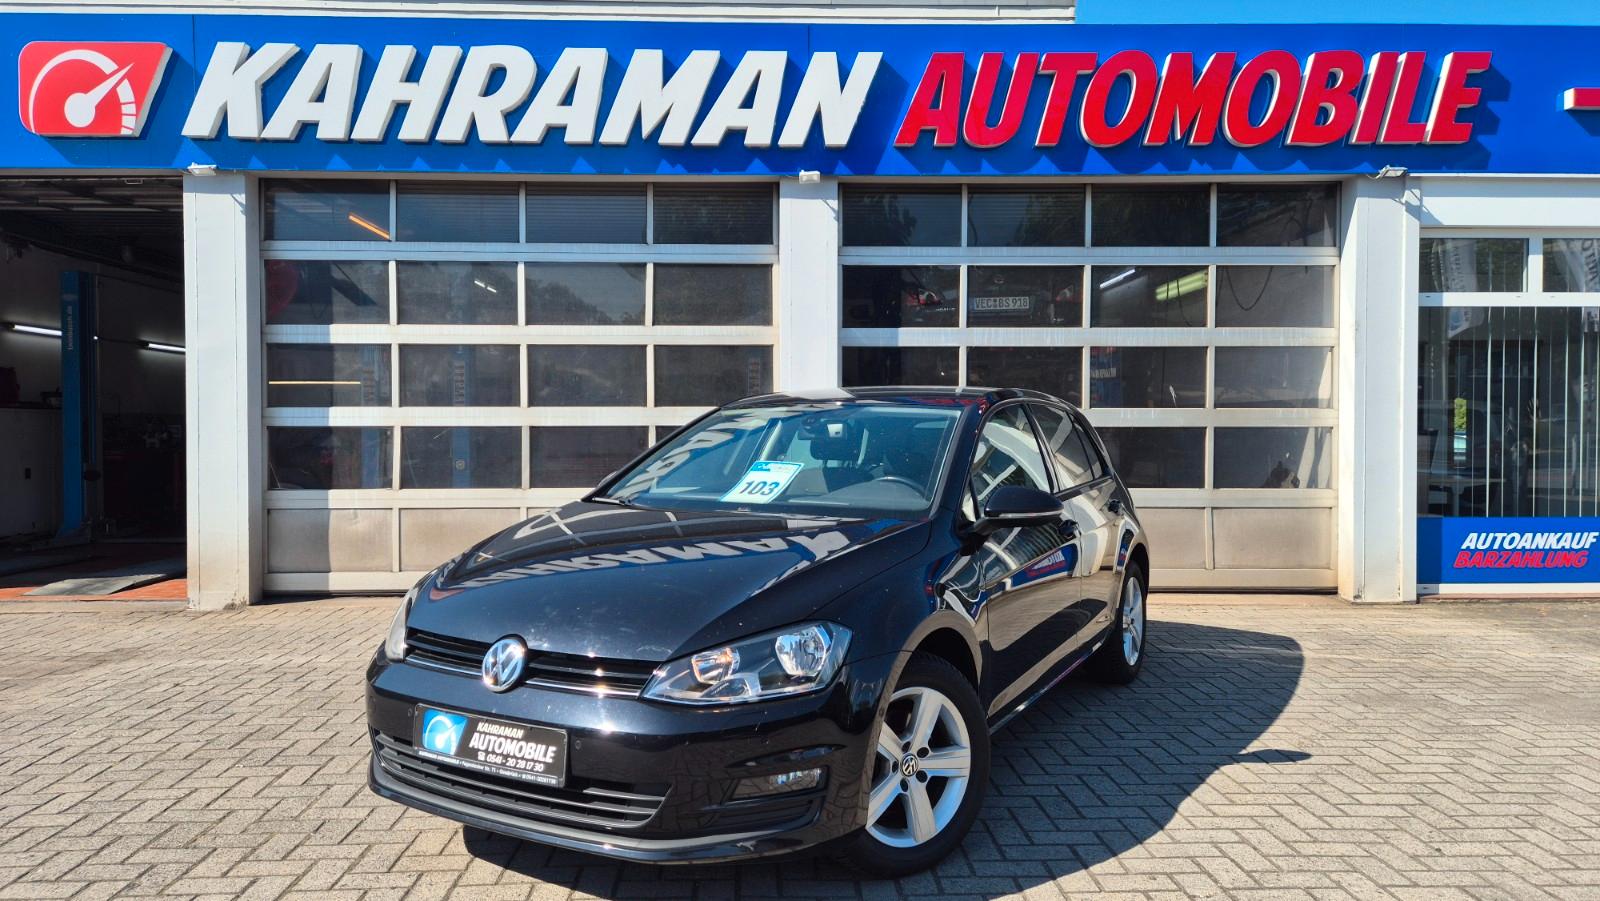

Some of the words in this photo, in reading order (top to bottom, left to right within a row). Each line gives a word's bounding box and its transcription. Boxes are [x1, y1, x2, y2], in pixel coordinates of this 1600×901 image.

[181, 41, 882, 148] KAHRAMAN
[894, 49, 1491, 149] AUTOMOBILE
[976, 298, 992, 309] VEC
[1012, 297, 1028, 307] 918
[740, 480, 780, 496] 103
[1461, 532, 1599, 550] AUTOANKAUF
[1453, 551, 1589, 569] BARZAHLUNG
[476, 722, 524, 739] KAHRAMAN
[469, 732, 557, 763] AUTOMOBILE
[486, 753, 502, 764] 0541
[506, 757, 516, 767] 20
[533, 763, 544, 772] 30
